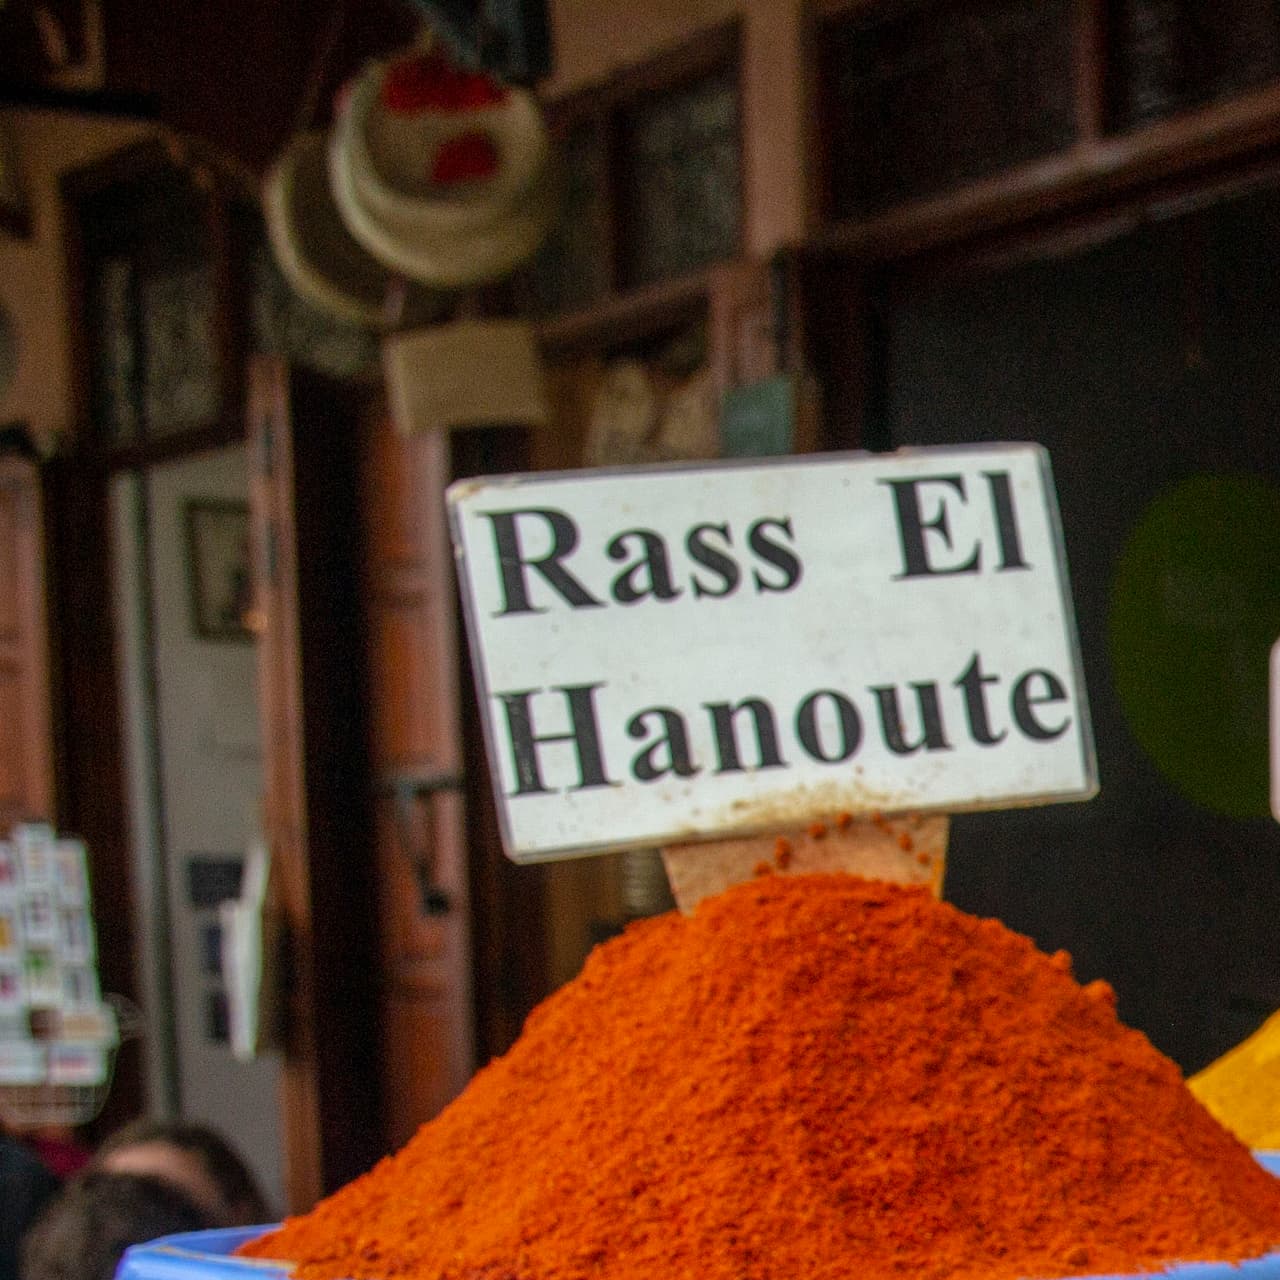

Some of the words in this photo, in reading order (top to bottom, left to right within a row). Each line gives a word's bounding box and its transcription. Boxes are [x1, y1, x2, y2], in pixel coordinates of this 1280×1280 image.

[476, 506, 805, 618] Rass
[878, 469, 1033, 583] El
[494, 651, 1073, 796] Hanoute
